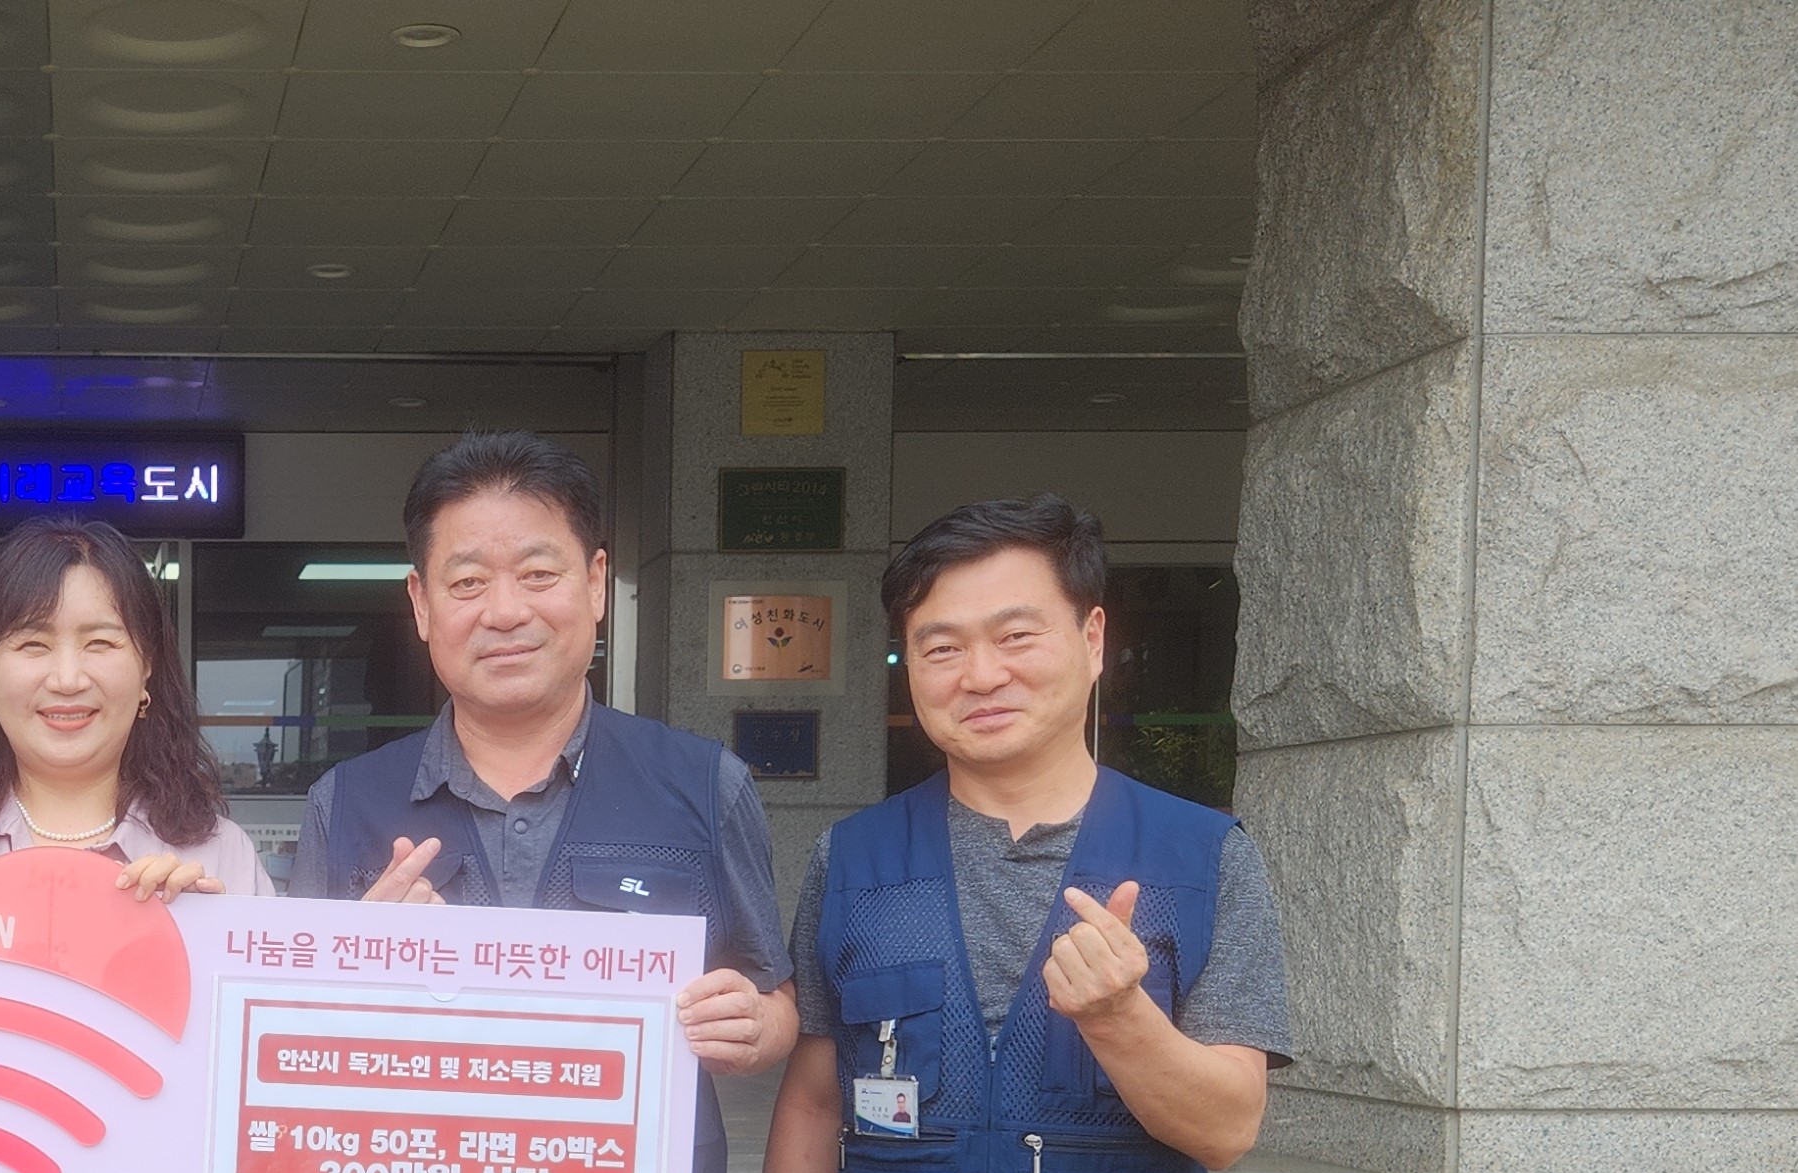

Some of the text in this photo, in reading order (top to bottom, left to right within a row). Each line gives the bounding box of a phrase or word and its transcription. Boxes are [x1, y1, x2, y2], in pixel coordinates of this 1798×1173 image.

[619, 877, 650, 897] SL
[227, 930, 675, 983] 나눔을 전파하는 따뜻한 에너지
[277, 1049, 602, 1087] 안산시 독거노인 및 저소득층 지원
[248, 1120, 625, 1168] 쌀 10kg 50포, 라면 50박스
